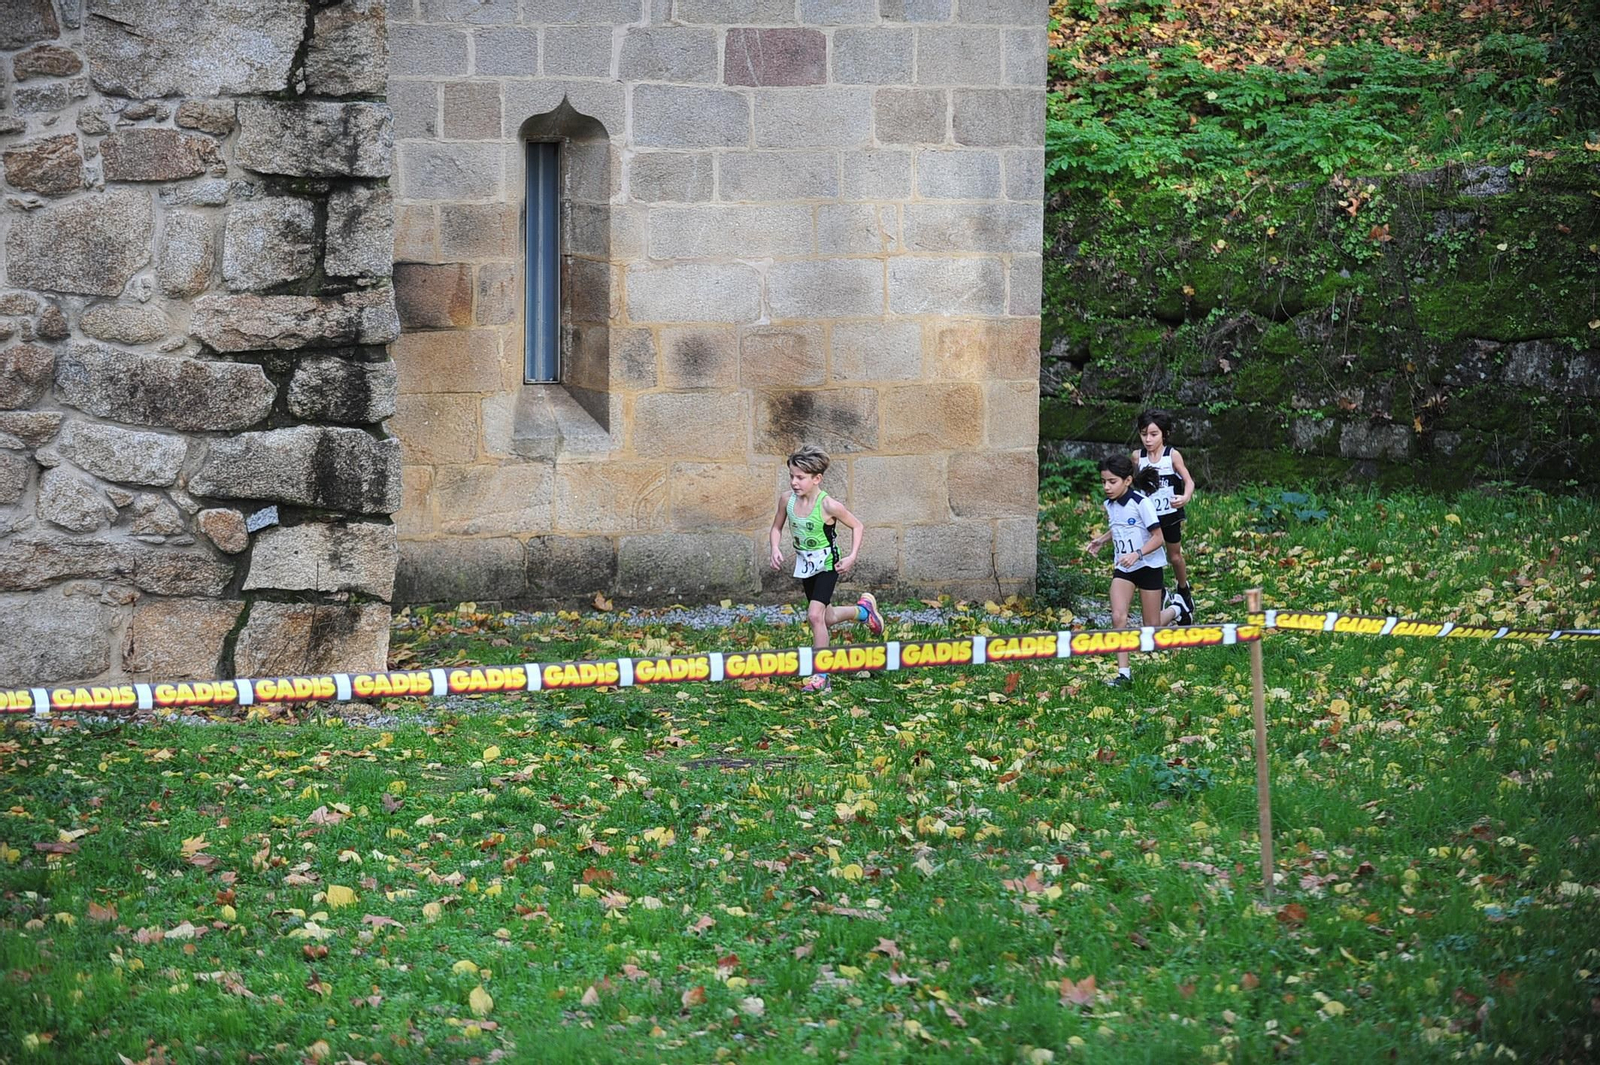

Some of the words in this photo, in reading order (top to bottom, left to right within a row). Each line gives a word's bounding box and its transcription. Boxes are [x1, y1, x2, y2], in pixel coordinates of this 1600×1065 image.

[1275, 613, 1326, 630] GADIS
[1334, 616, 1386, 634] GADIS
[1390, 621, 1443, 636] GADIS
[52, 685, 137, 709] GADIS
[154, 681, 238, 705] GADIS
[254, 676, 336, 701] GADIS
[353, 671, 433, 696] GADIS
[449, 666, 528, 692] GADIS
[542, 661, 619, 688] GADIS
[634, 656, 710, 683] GADIS
[725, 651, 799, 677] GADIS
[813, 646, 887, 671] GADIS
[901, 640, 973, 667] GADIS
[986, 635, 1058, 661] GADIS
[1071, 630, 1141, 653] GADIS
[1154, 626, 1223, 646] GADIS
